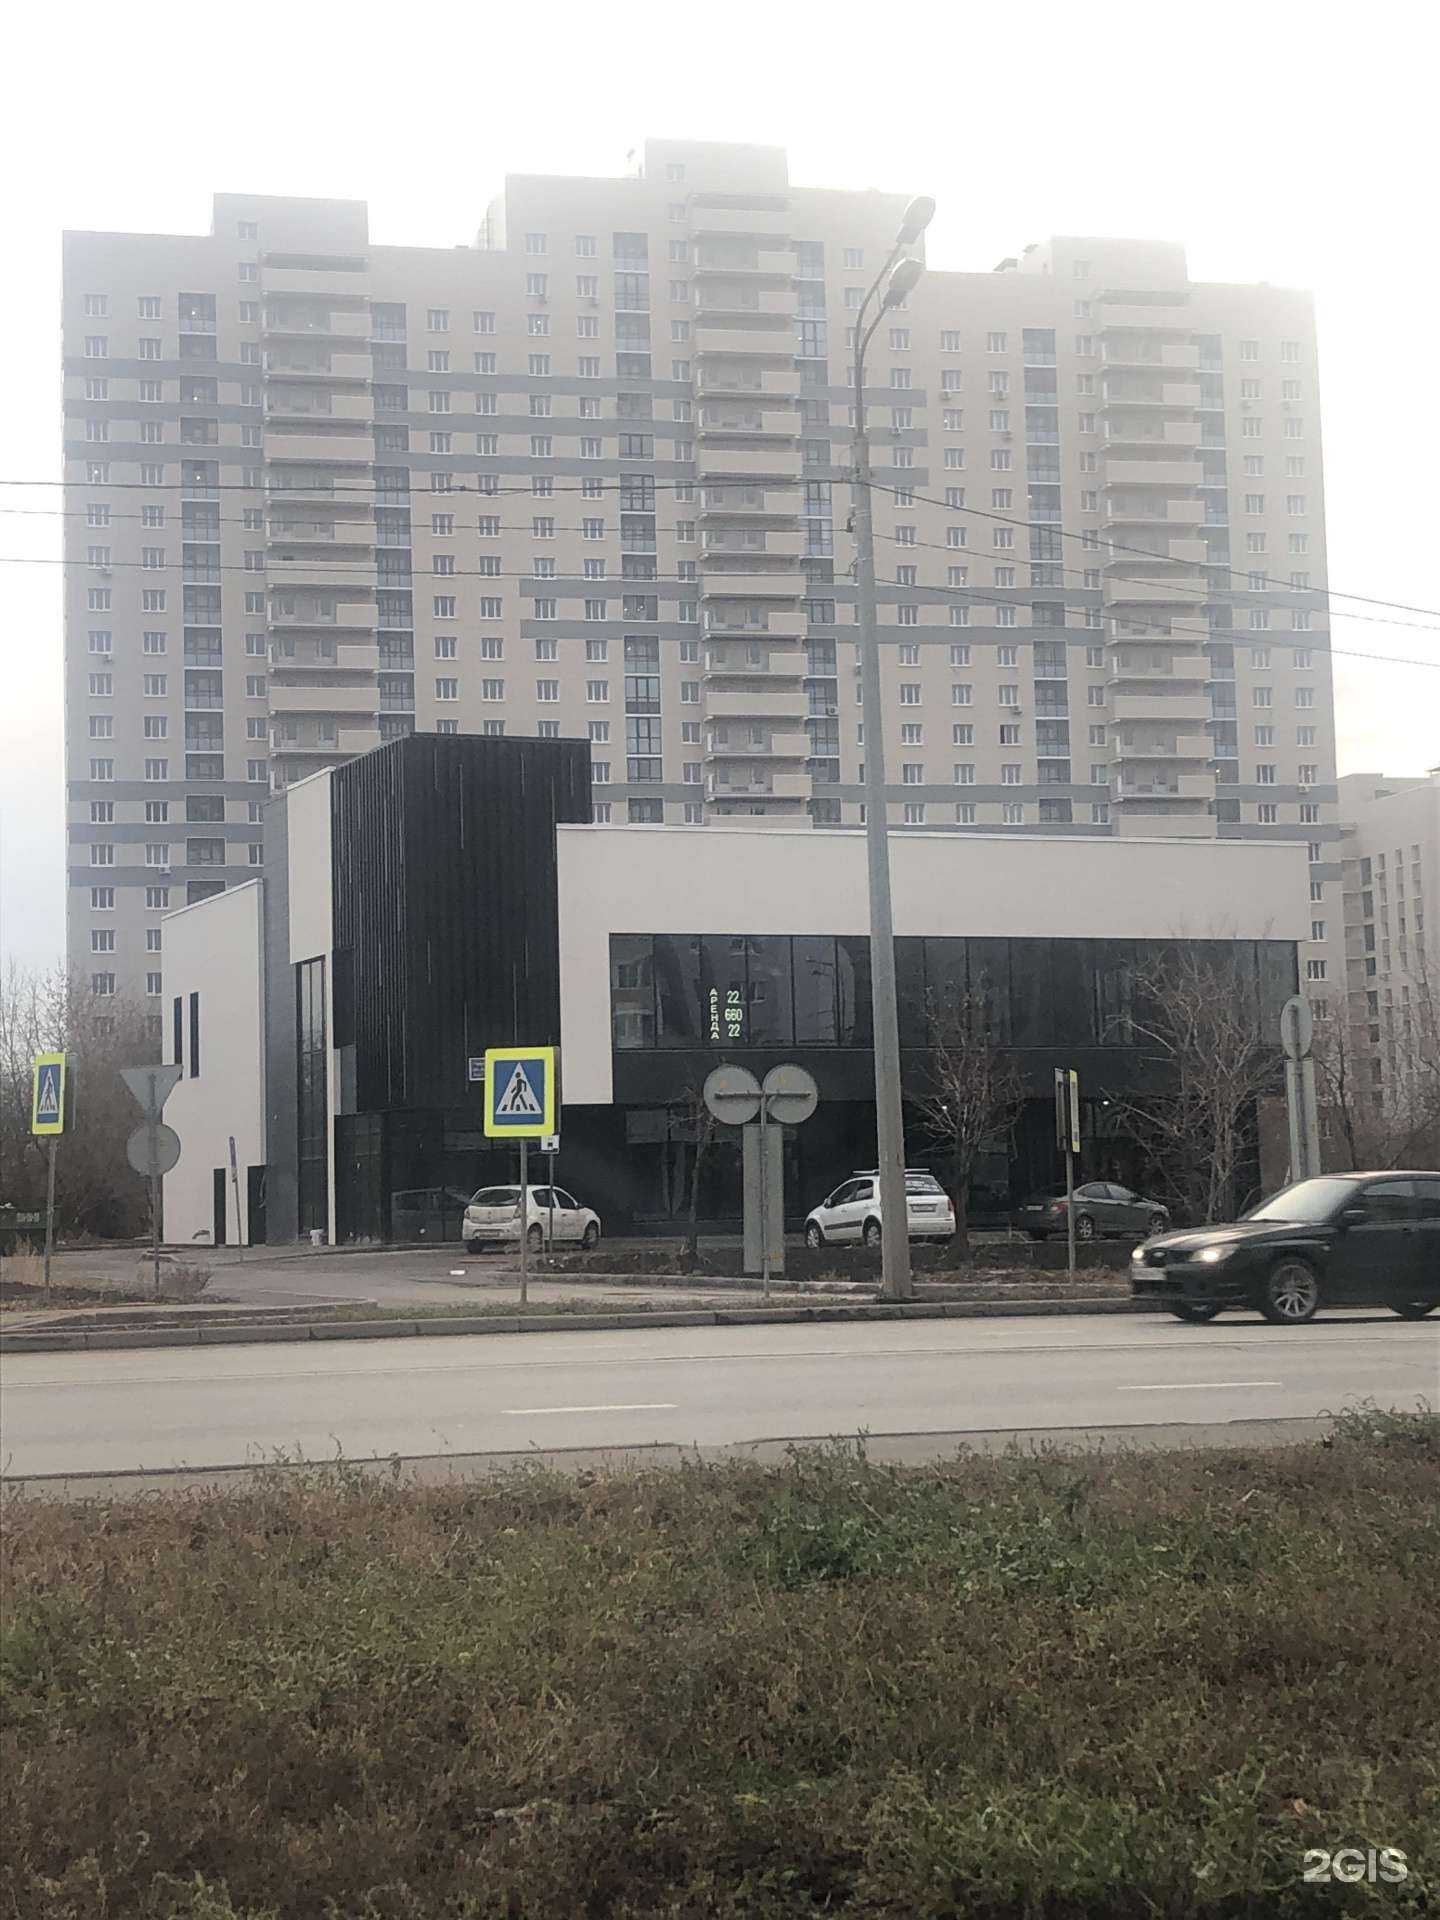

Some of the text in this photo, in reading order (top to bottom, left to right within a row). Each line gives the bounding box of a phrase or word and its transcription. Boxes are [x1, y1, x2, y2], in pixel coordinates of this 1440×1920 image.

[726, 990, 740, 1004] 22
[709, 988, 720, 1040] АРЕНДА
[727, 1023, 741, 1037] 22
